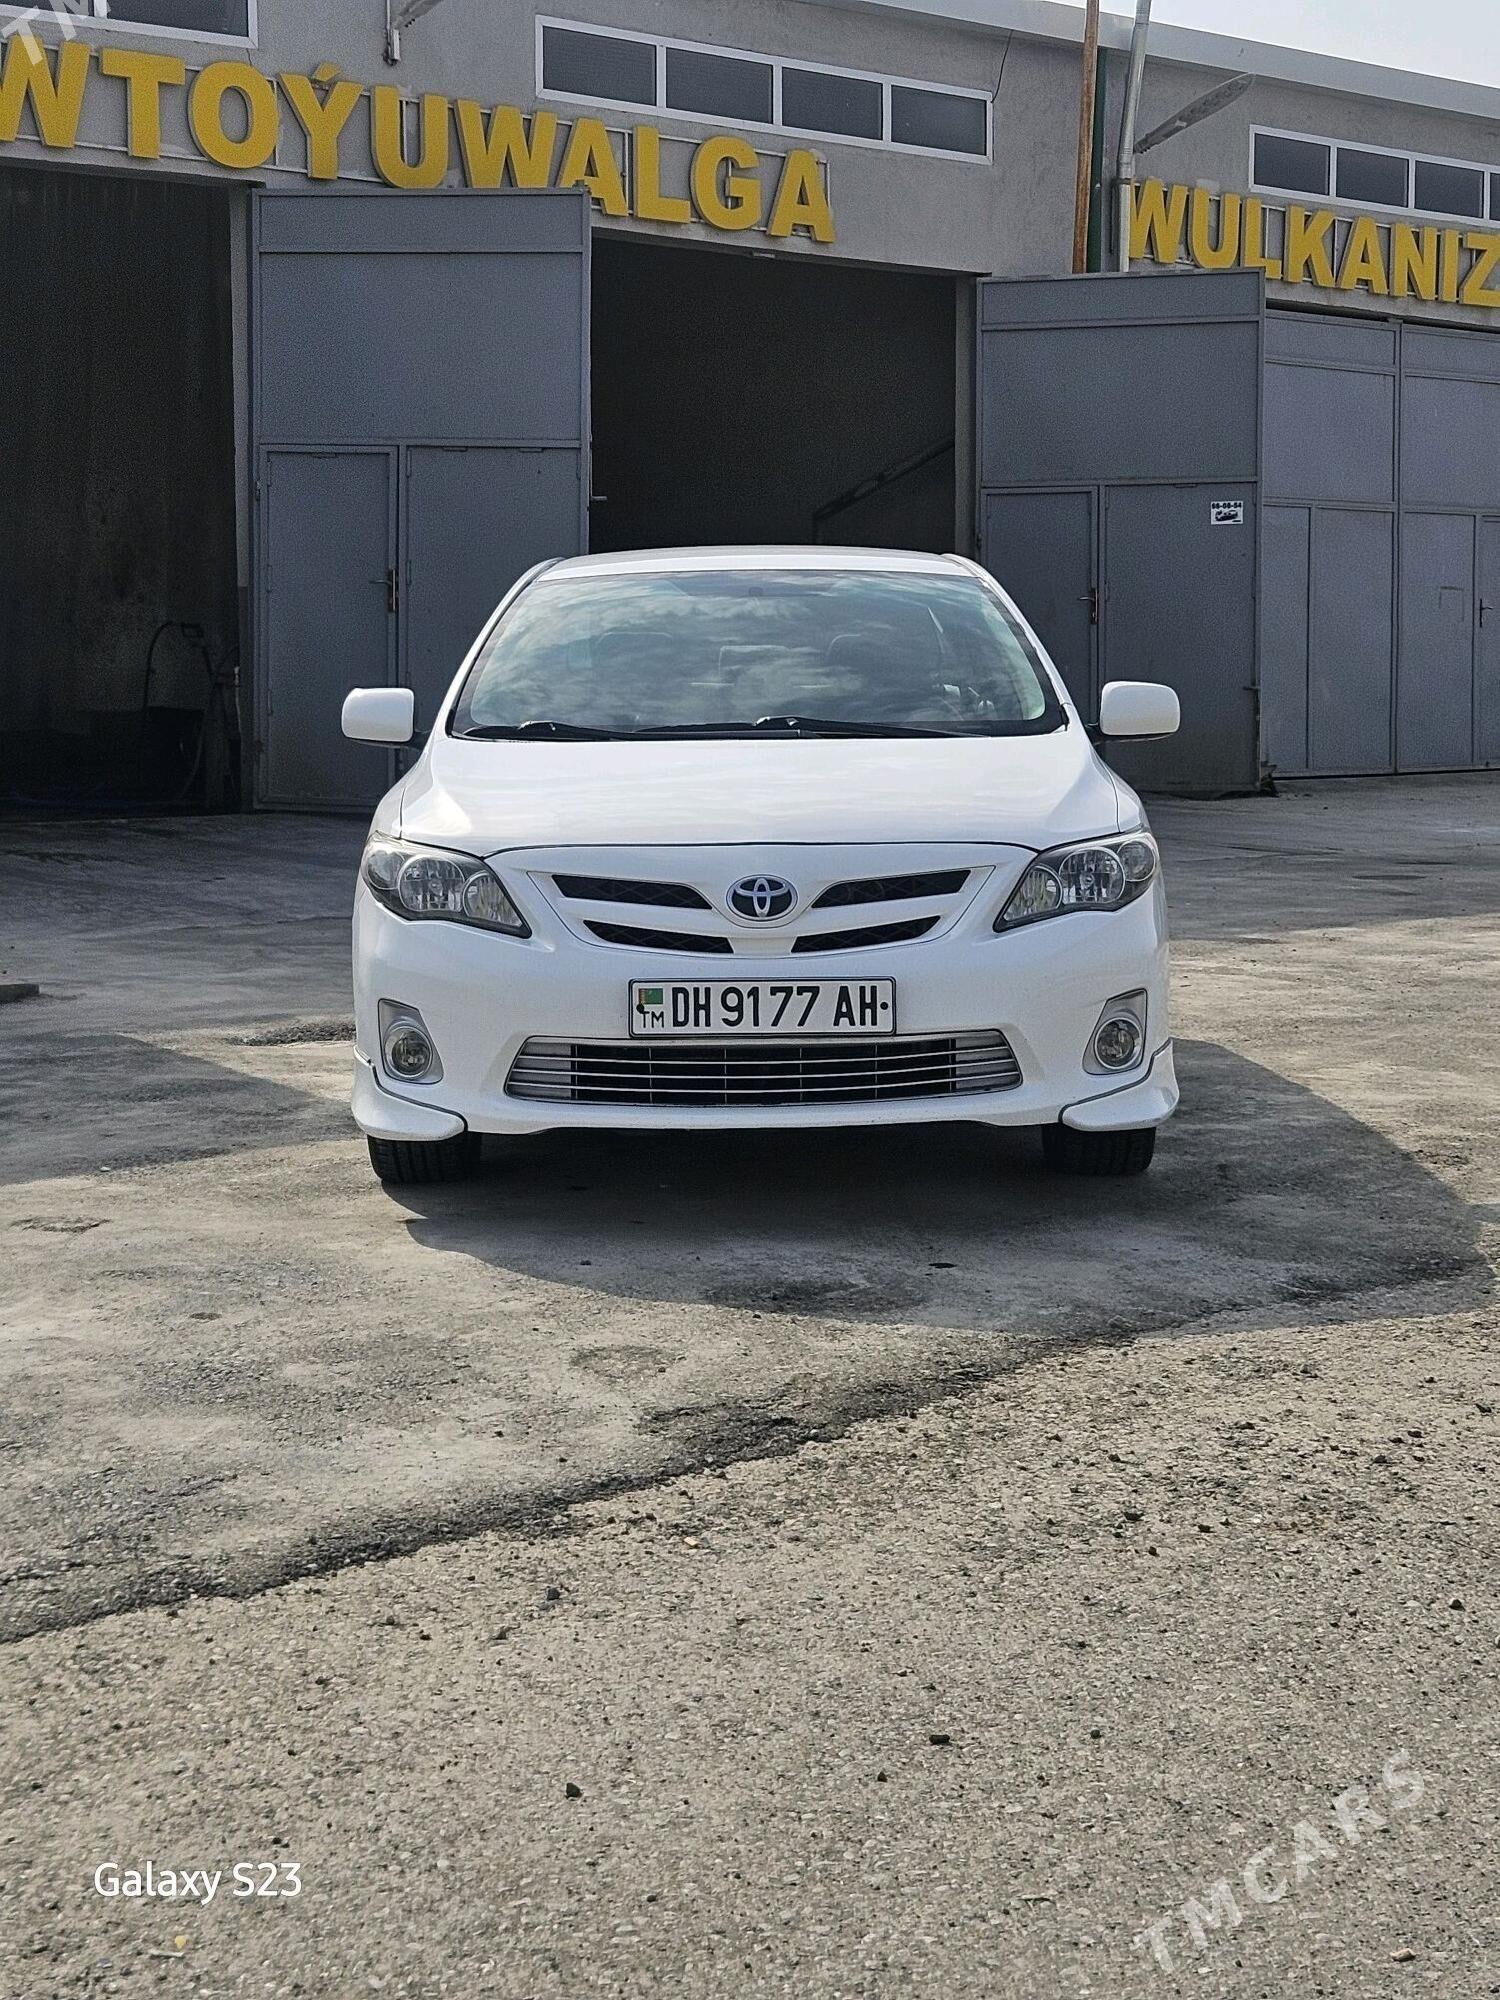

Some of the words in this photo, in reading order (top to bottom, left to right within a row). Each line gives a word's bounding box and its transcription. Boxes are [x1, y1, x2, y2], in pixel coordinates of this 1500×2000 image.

[641, 1010, 665, 1028] TM
[672, 986, 711, 1027] DH
[720, 986, 821, 1027] 9177
[833, 985, 878, 1026] AH
